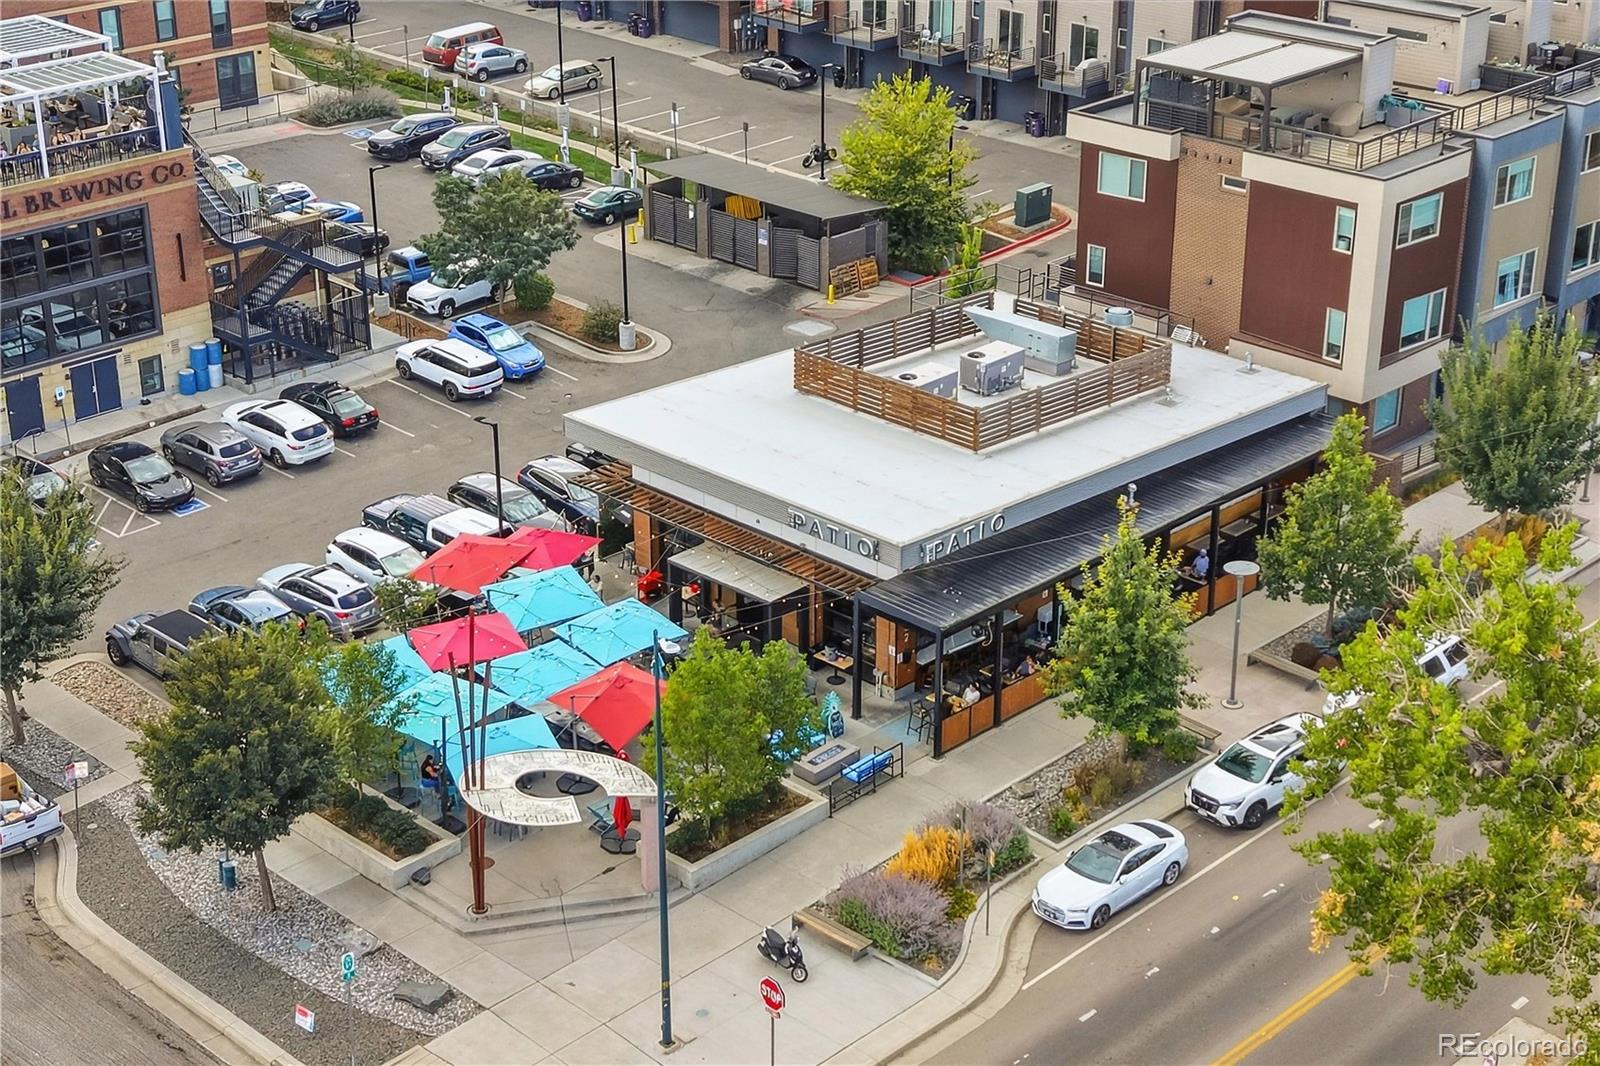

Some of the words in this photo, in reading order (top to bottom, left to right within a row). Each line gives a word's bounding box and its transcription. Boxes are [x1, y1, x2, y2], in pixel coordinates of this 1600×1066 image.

[23, 170, 144, 214] BREWING
[792, 511, 874, 558] PATIO
[933, 513, 1005, 560] PATIO
[761, 983, 782, 1004] STOP
